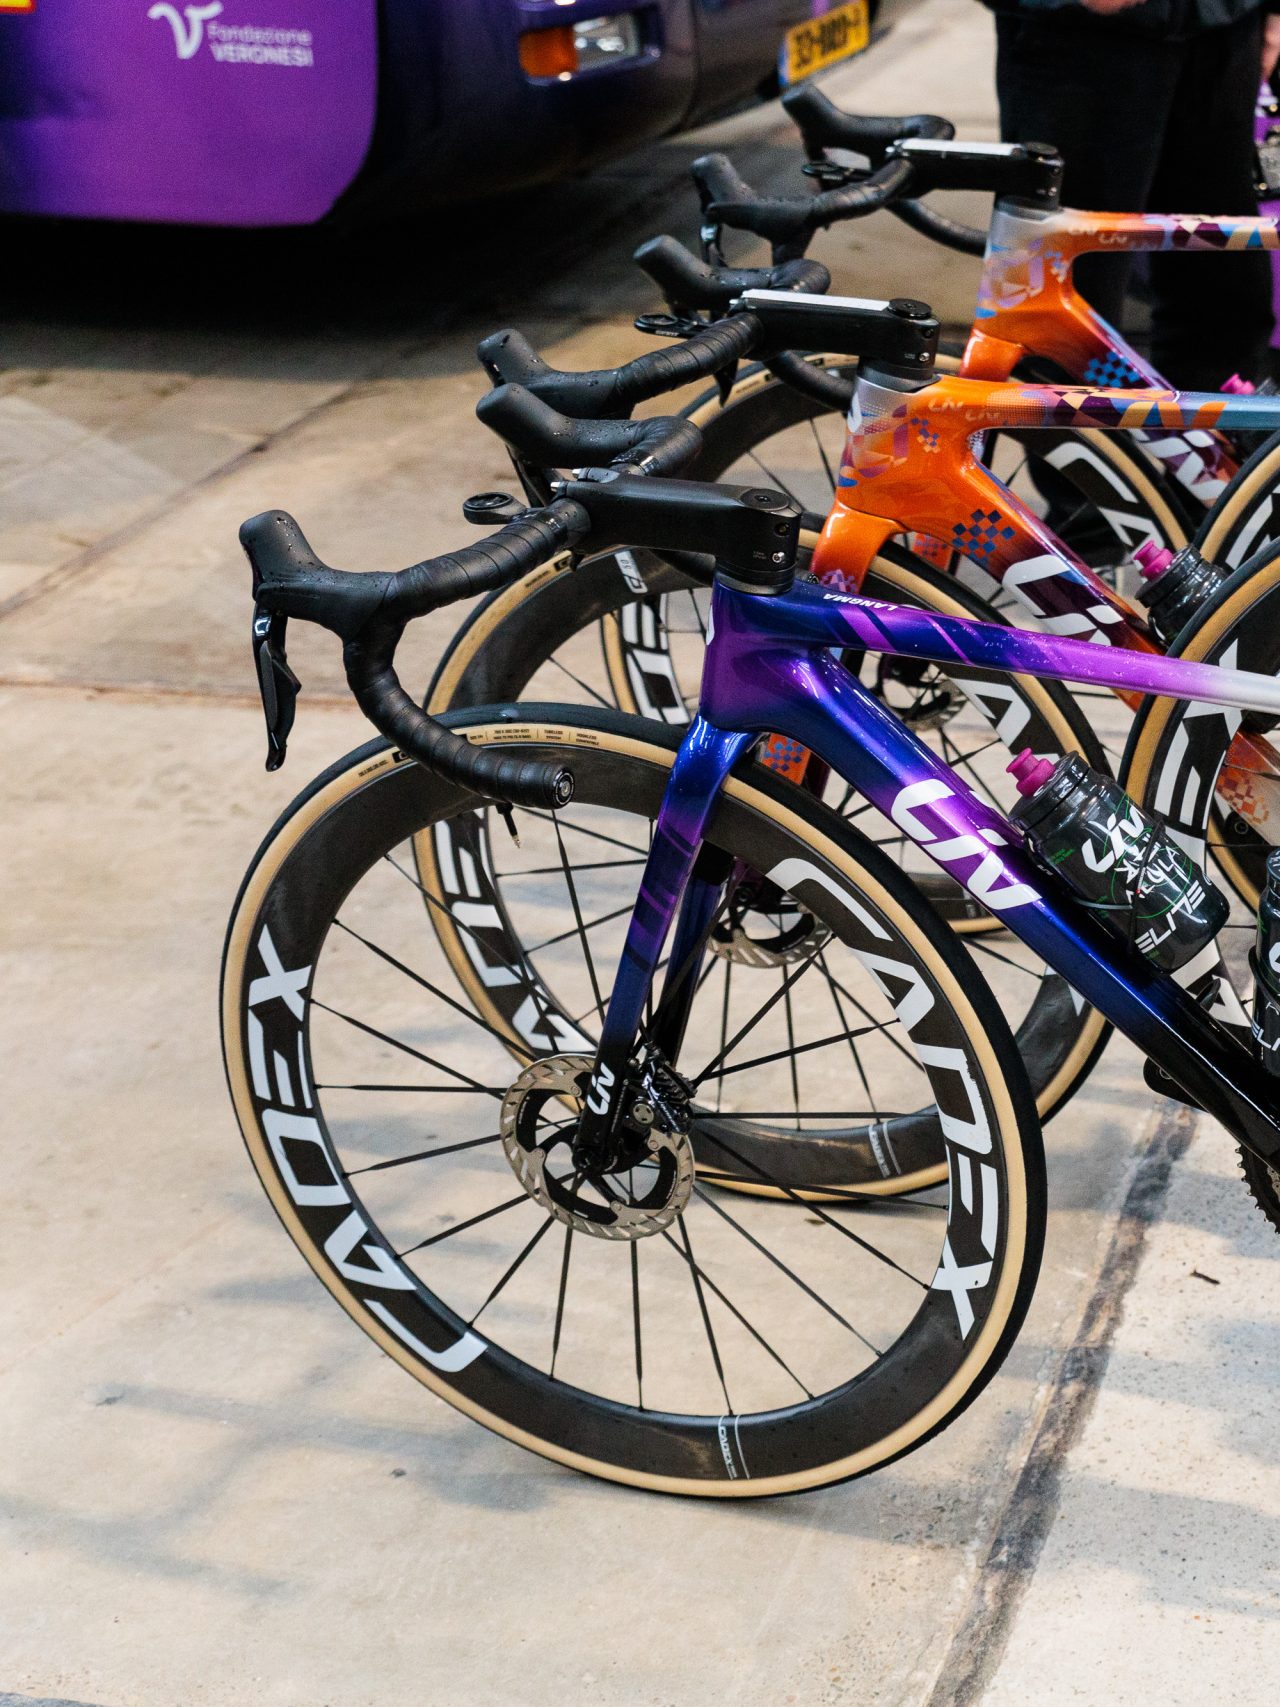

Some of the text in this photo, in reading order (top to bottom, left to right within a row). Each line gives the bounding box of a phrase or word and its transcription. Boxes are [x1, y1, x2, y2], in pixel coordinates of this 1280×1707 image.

[207, 22, 312, 46] Fondazione
[209, 42, 314, 67] VERONESI
[823, 593, 898, 612] LANGMA
[891, 778, 1043, 910] Liv
[1081, 805, 1146, 873] Liv
[1135, 880, 1206, 954] ELITE
[586, 1061, 616, 1116] Liv
[765, 857, 998, 1340] CADEX
[247, 922, 488, 1373] CADEX
